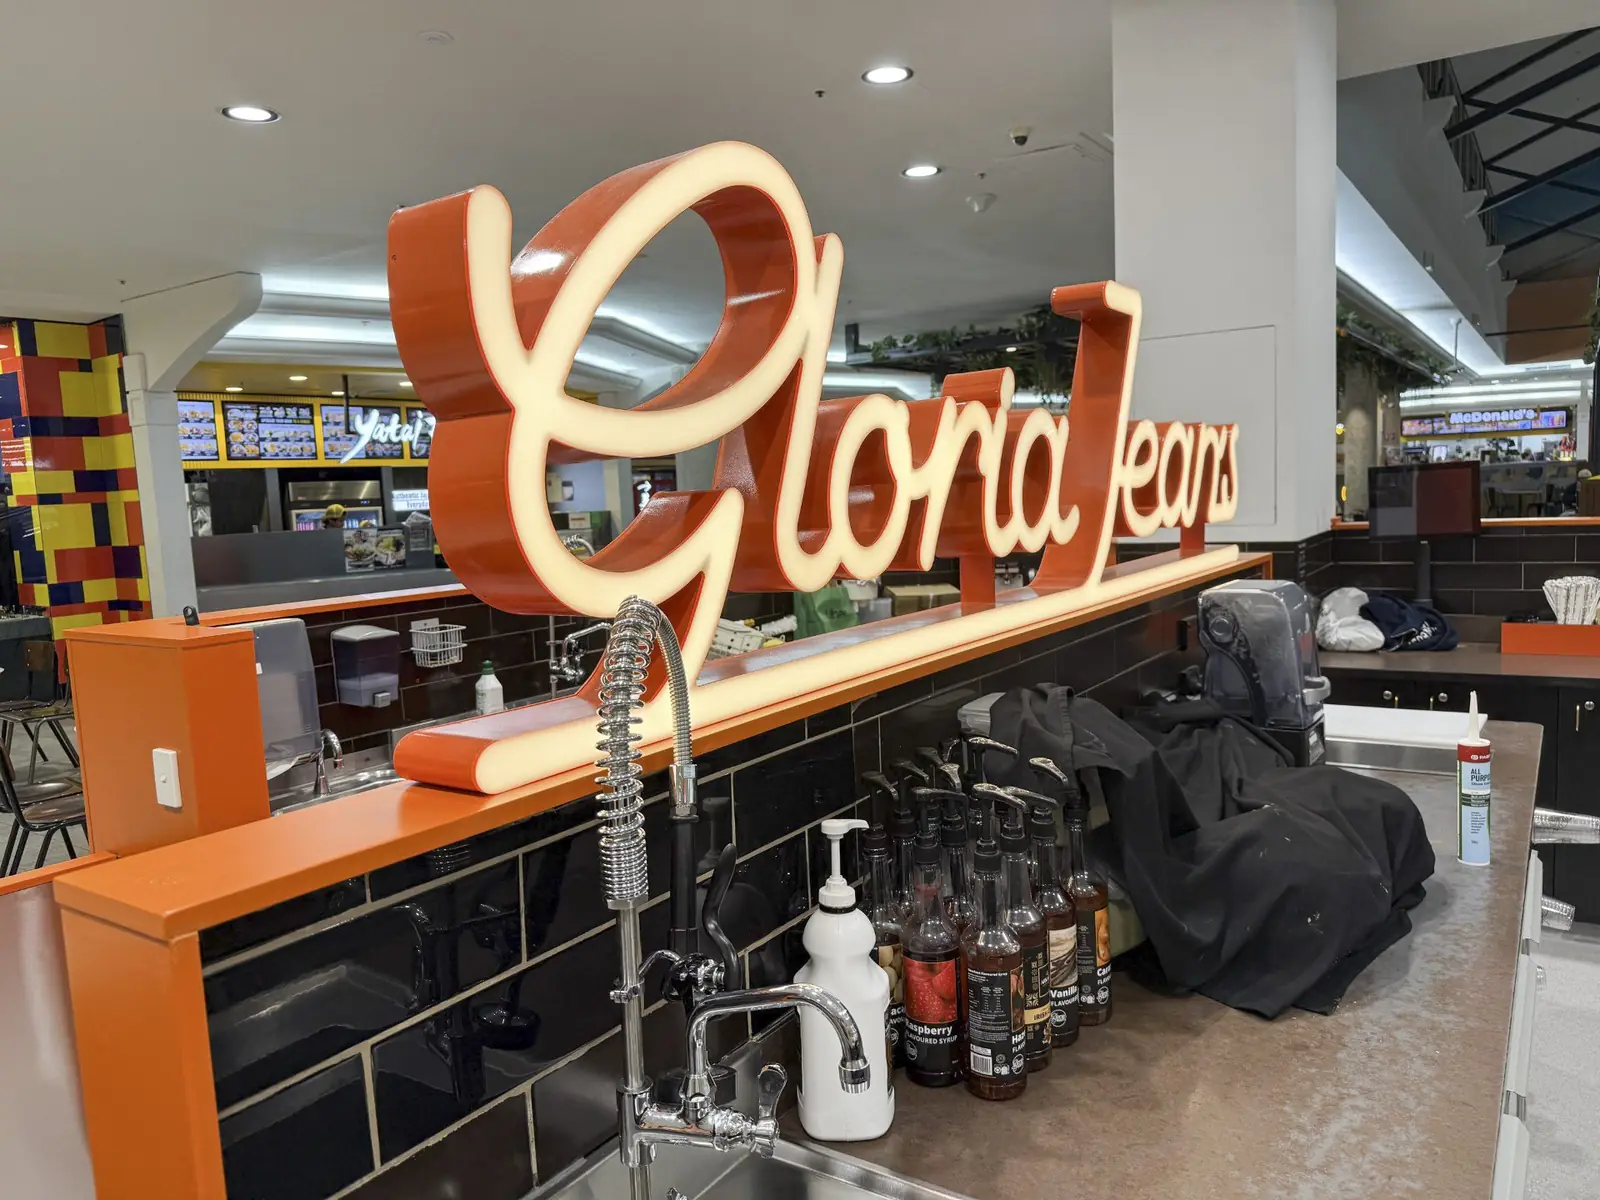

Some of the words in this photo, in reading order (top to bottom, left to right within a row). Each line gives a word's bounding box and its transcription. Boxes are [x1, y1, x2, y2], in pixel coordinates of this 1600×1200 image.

[430, 140, 1080, 690] Gloria
[1052, 279, 1240, 588] Jeans
[1449, 408, 1537, 424] McDonald's
[939, 1034, 958, 1045] SYRUP
